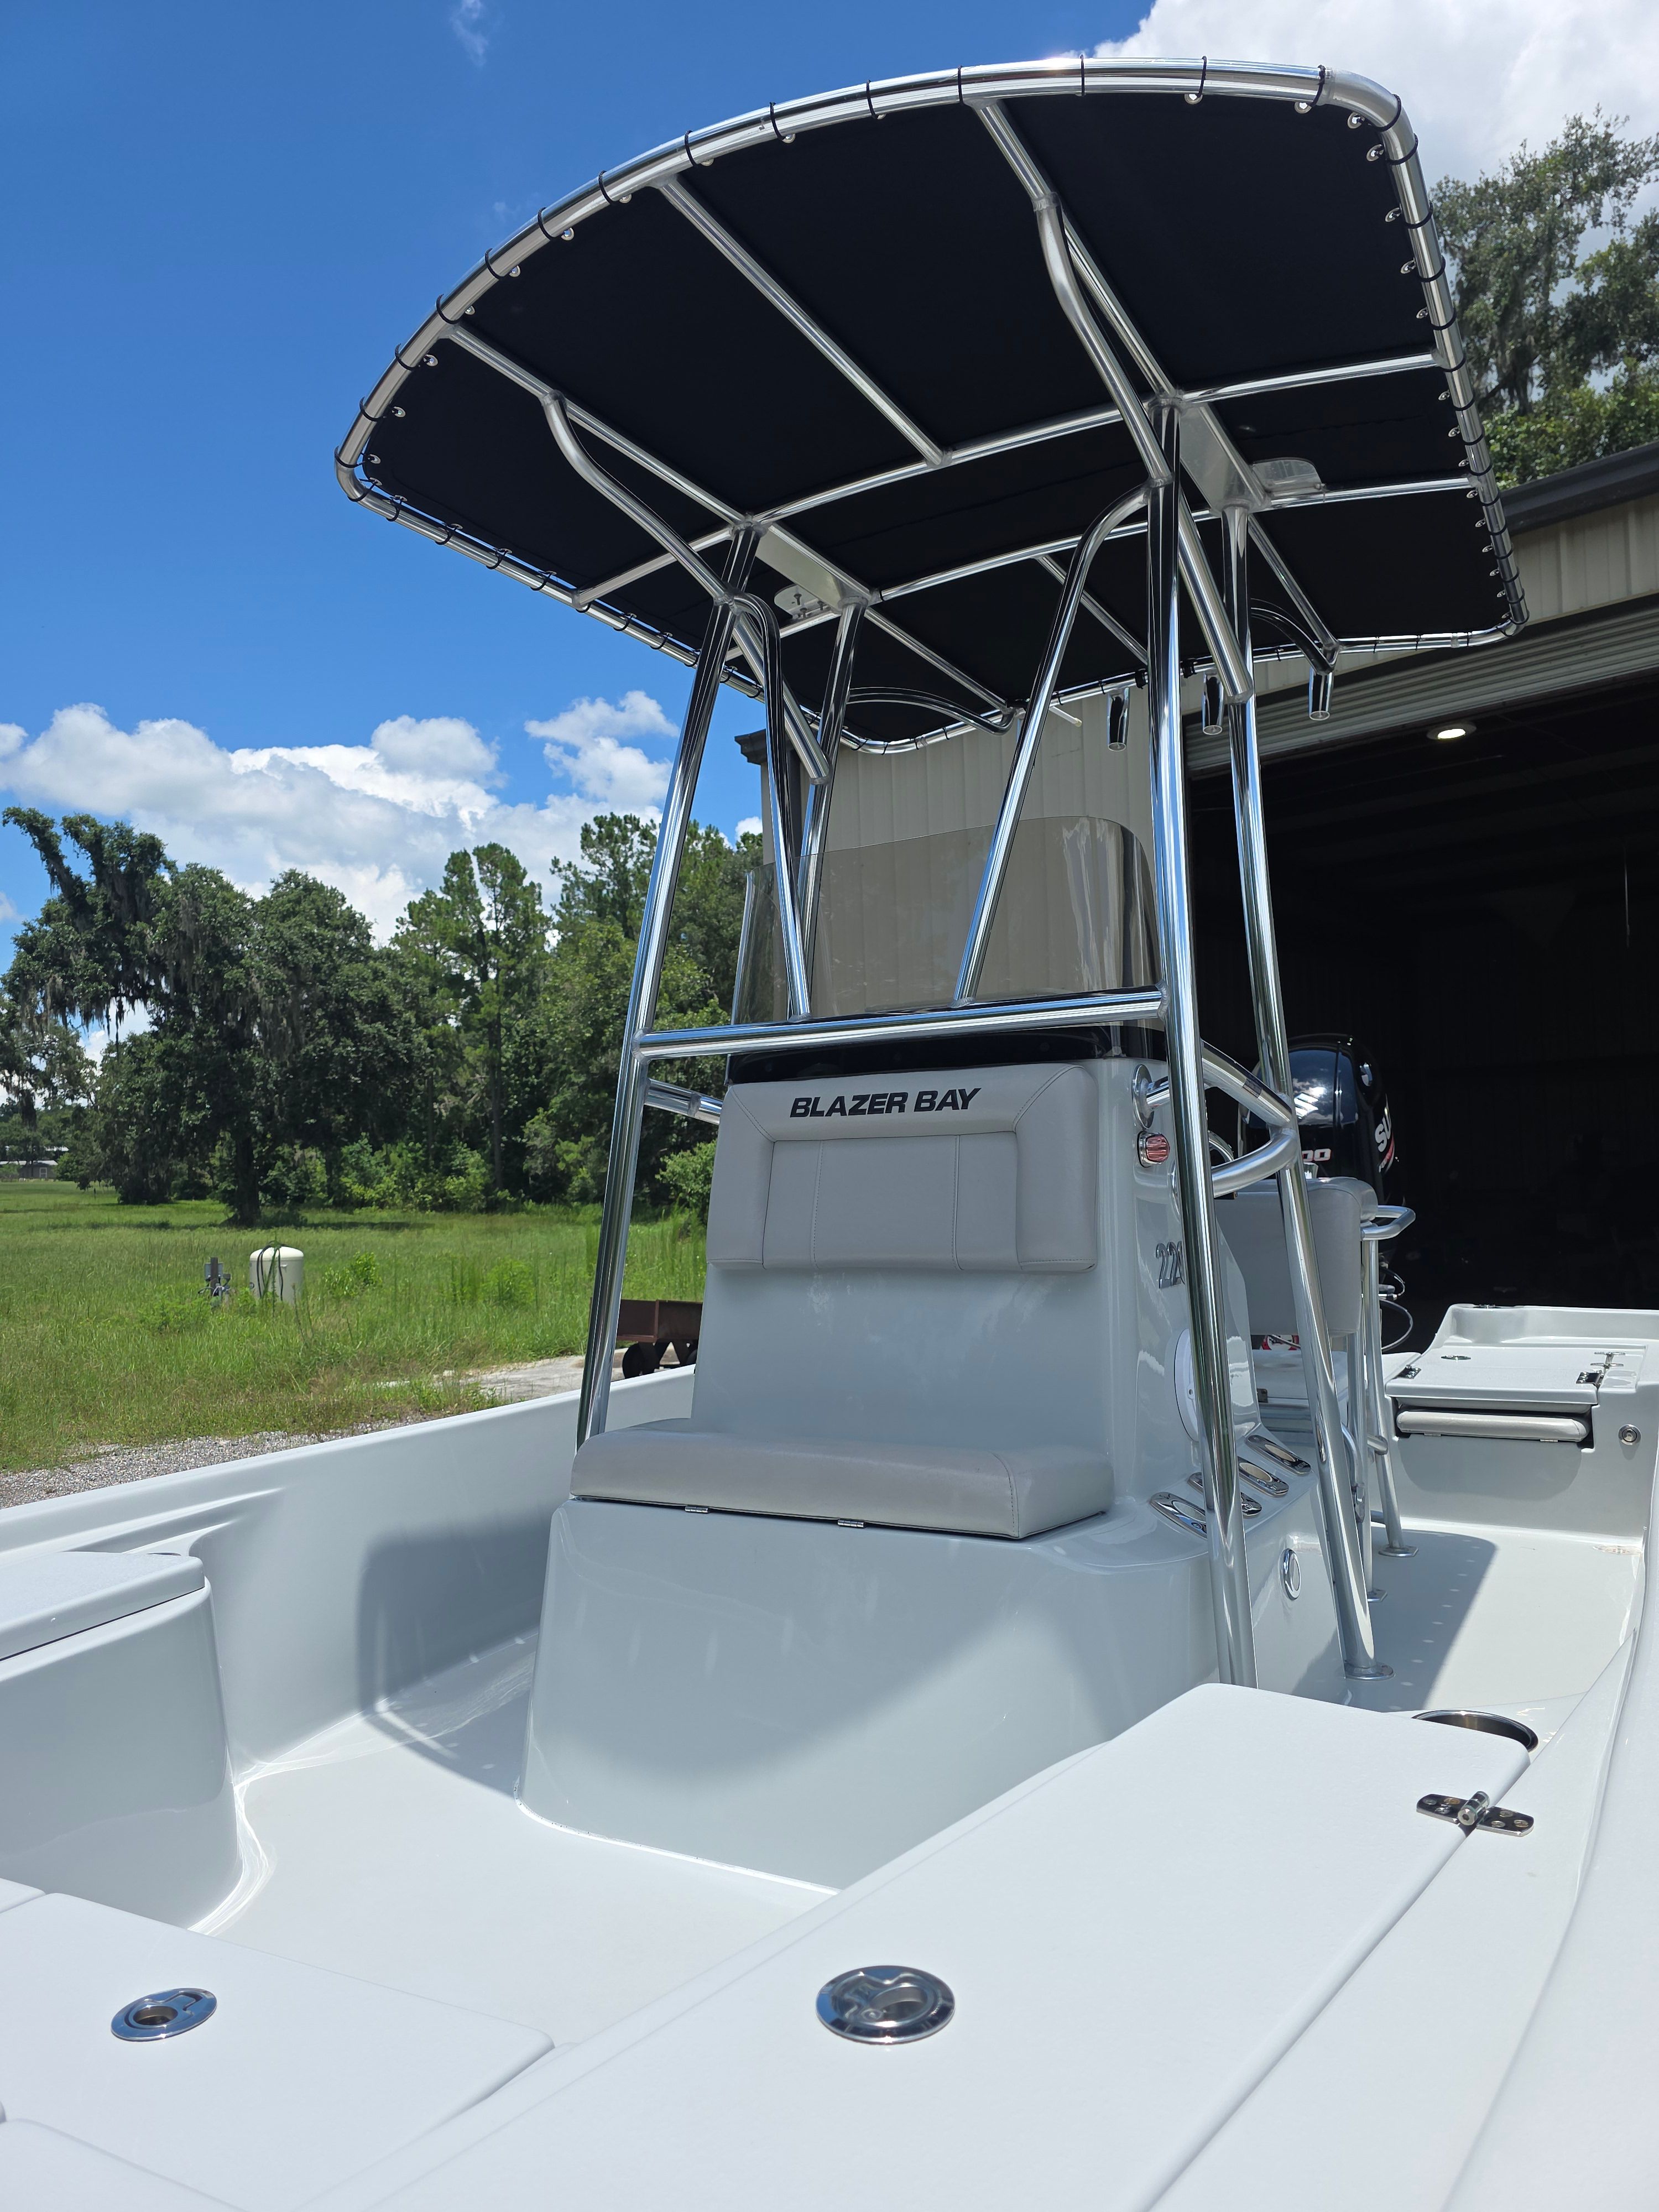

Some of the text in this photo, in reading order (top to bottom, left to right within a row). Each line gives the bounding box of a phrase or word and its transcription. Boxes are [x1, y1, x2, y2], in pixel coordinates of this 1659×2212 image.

[790, 1087, 982, 1118] BLAZER BAY
[1375, 1107, 1392, 1152] SU
[1302, 1148, 1332, 1162] 00
